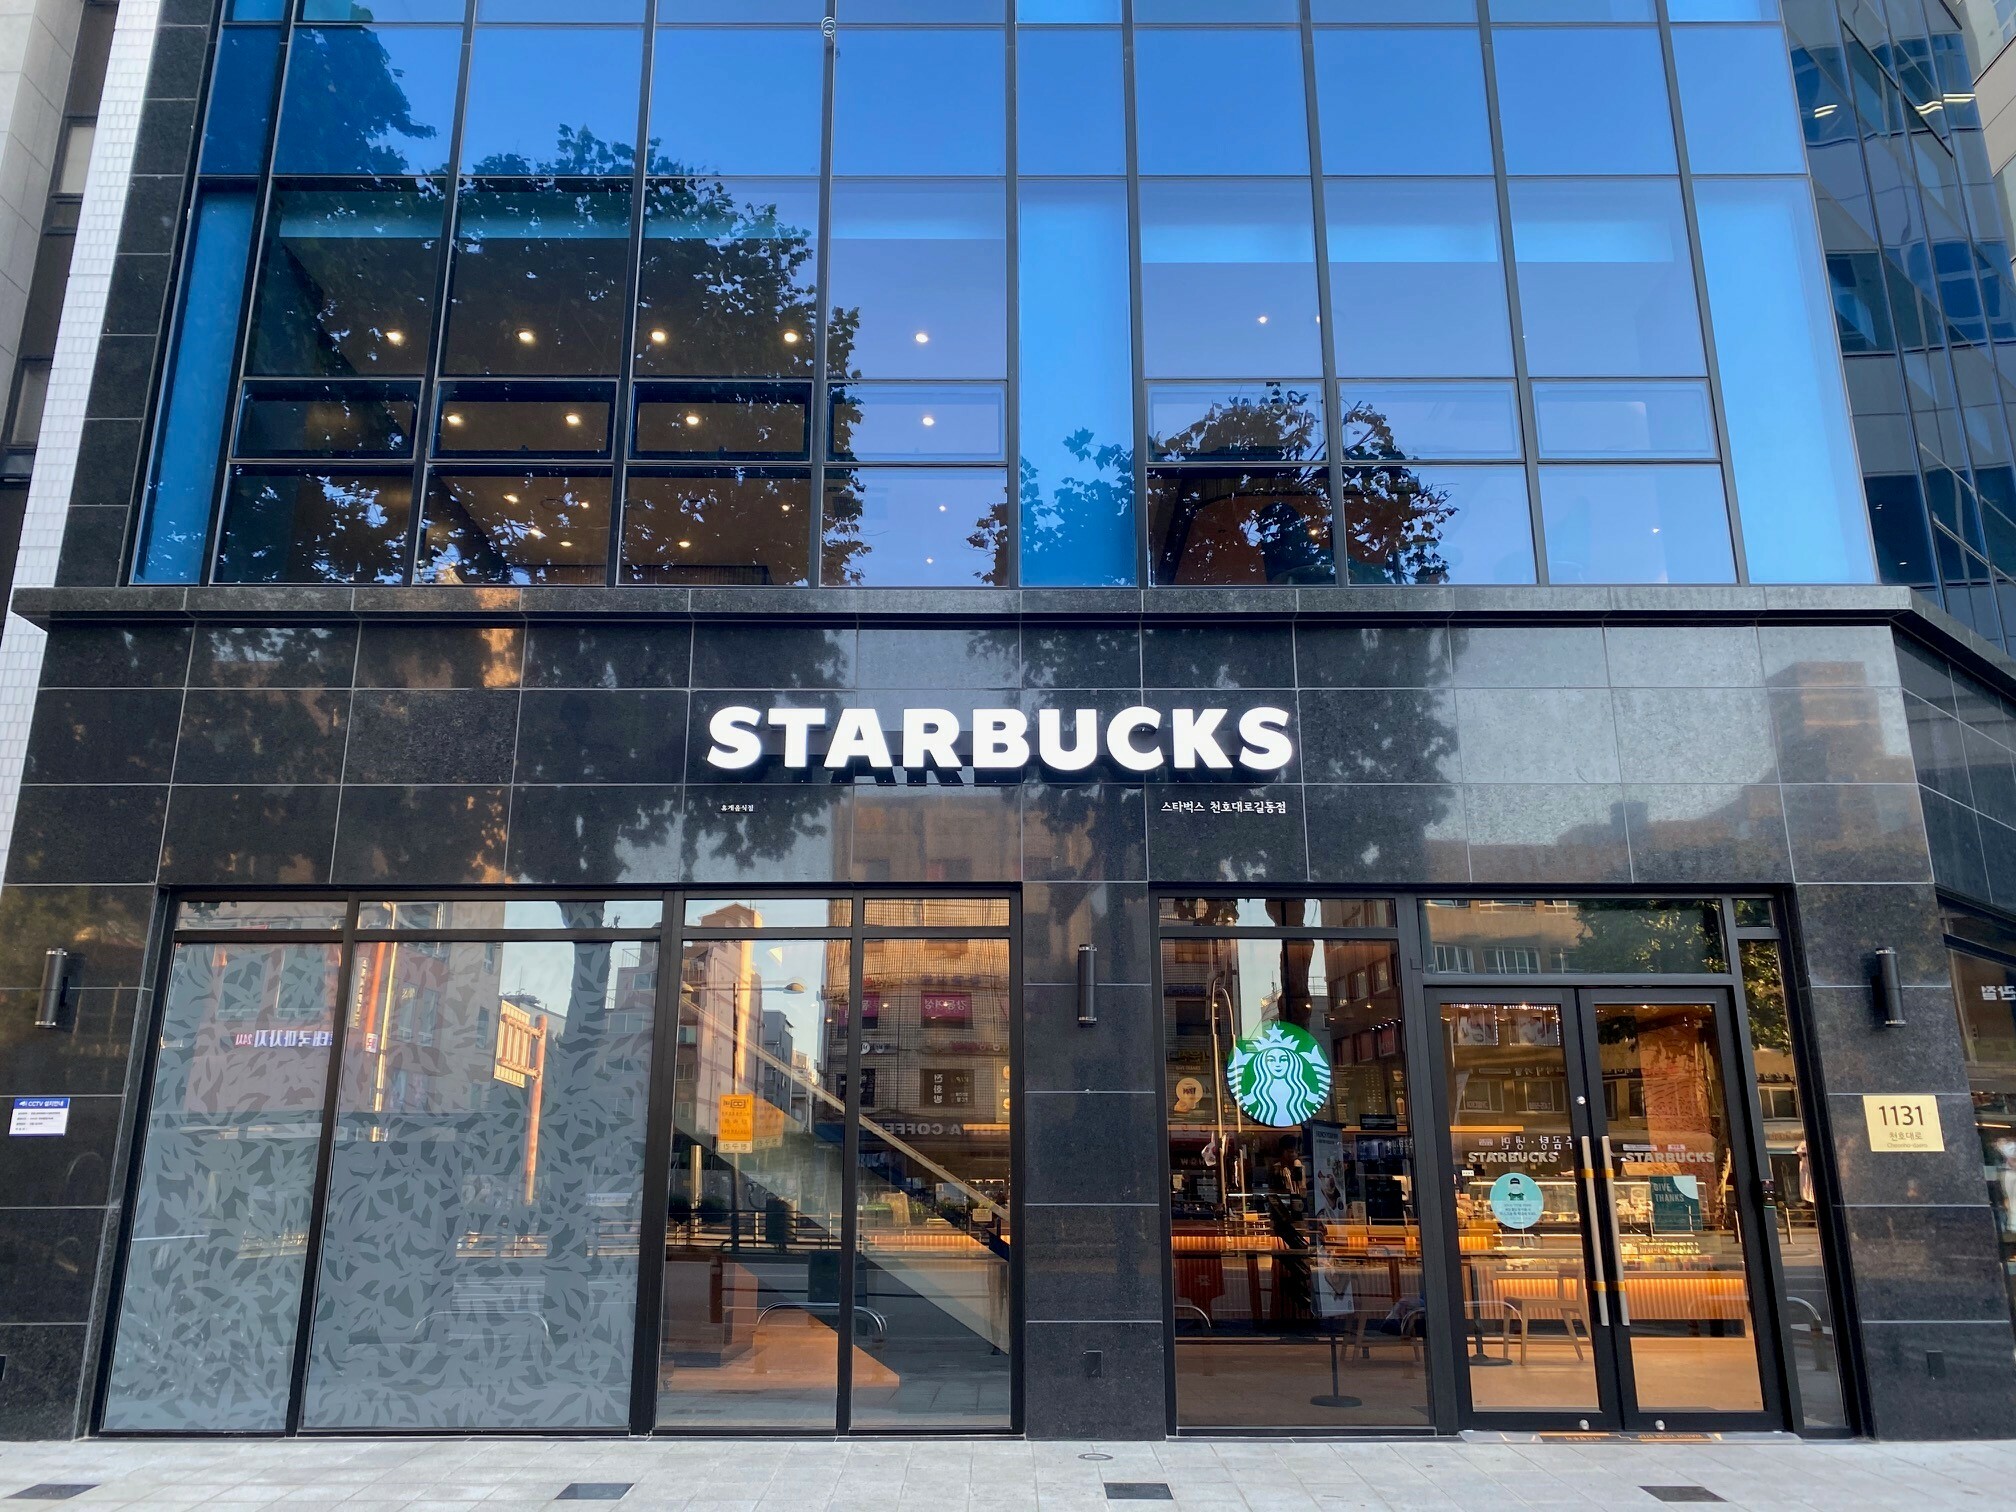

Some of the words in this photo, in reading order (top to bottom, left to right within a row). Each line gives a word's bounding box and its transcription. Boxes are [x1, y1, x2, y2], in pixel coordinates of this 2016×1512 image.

[706, 706, 1293, 771] STARBUCKS
[1161, 801, 1206, 813] 스타벅스
[1209, 801, 1286, 814] 천호대로길동점
[1878, 1105, 1924, 1126] 1131
[1888, 1131, 1923, 1141] 천호대로
[1468, 1151, 1558, 1164] STARBUCKS
[1625, 1151, 1715, 1164] STARBUCKS
[1653, 1182, 1672, 1192] GIVE
[1655, 1193, 1685, 1202] THANKS
